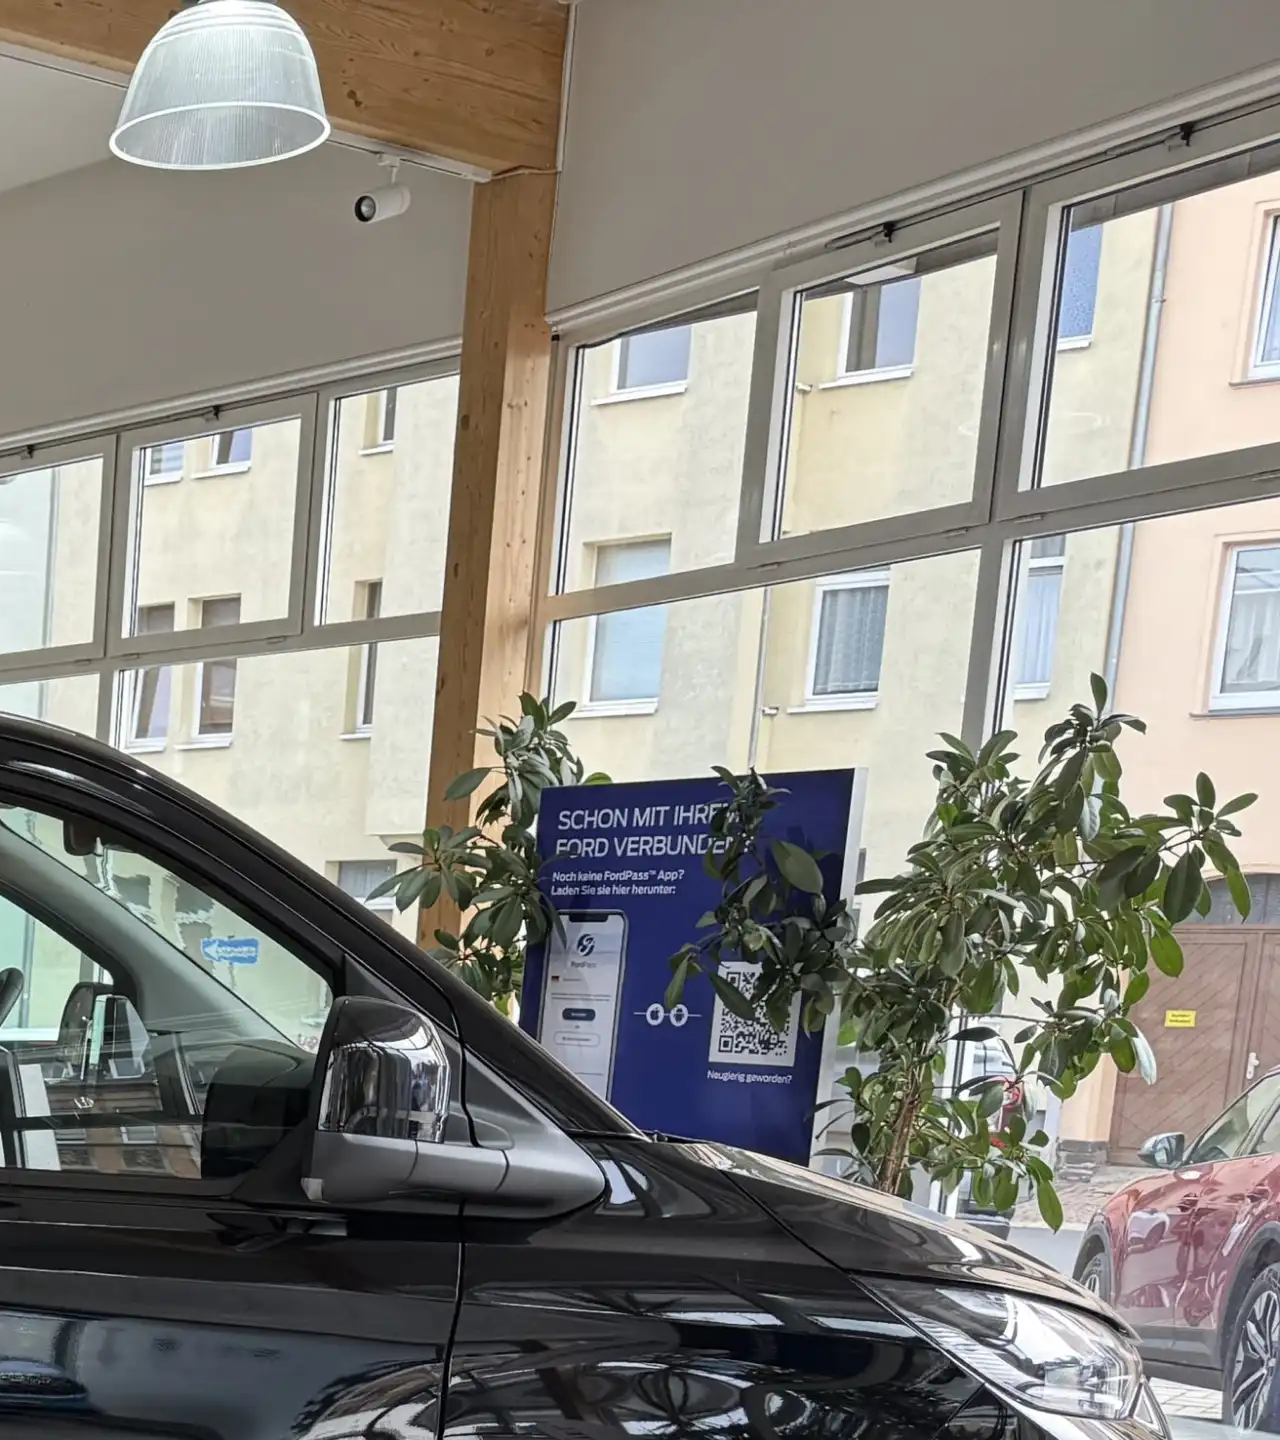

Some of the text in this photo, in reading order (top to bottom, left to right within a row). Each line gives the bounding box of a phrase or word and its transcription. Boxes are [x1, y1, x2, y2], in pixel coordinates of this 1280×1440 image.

[558, 808, 628, 830] SCHON
[632, 806, 670, 828] MIT
[556, 837, 609, 859] FORD
[552, 871, 577, 882] Noch
[578, 870, 603, 881] keine
[657, 868, 685, 882] App?
[551, 883, 677, 896] Laden Sie sie hier herunter:
[707, 1069, 792, 1084] Neugierig geworden?
